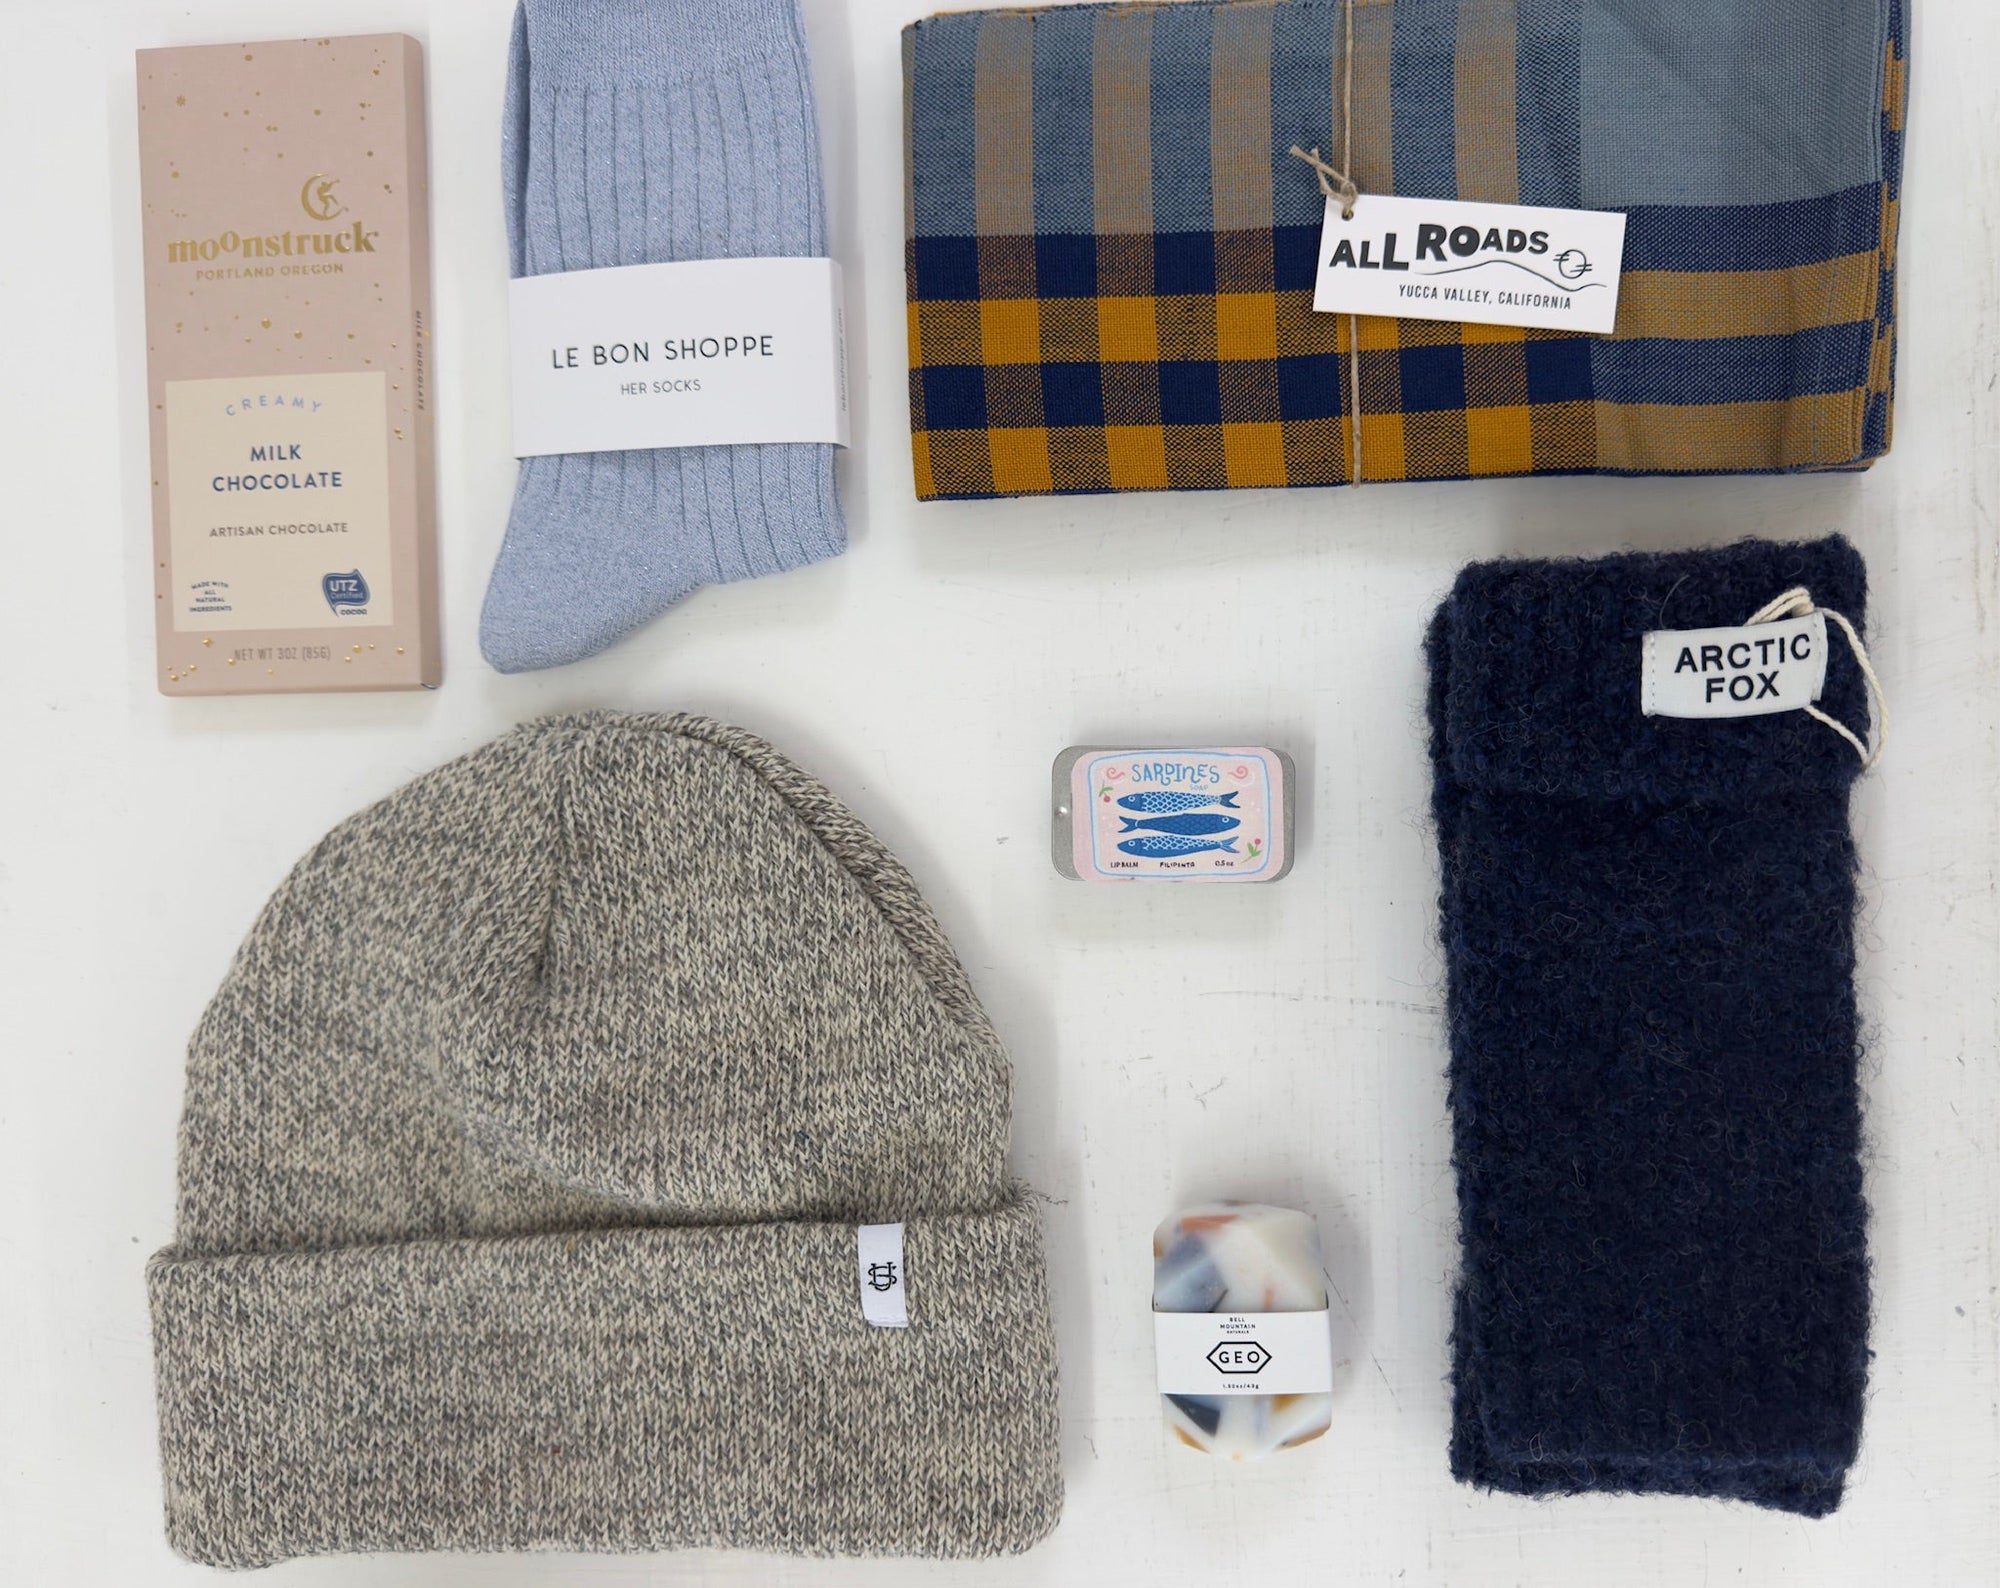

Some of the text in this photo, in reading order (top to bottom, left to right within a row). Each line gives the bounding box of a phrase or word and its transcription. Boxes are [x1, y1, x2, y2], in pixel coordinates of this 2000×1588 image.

[167, 221, 380, 263] moonstruck
[1329, 223, 1549, 271] ALL ROADS
[196, 263, 344, 281] PORTLAND OREGON
[1399, 284, 1572, 310] YUCCA VALLEY, CALIFORNIA
[552, 335, 774, 369] LE BON SHOPPE
[620, 379, 701, 396] HER SOCKS
[225, 395, 322, 416] CREAMY
[250, 444, 302, 462] MILK
[212, 471, 343, 492] CHOCOLATE
[209, 522, 349, 538] ARTISAN CHOCOLATE
[330, 579, 359, 592] UTZ
[234, 647, 254, 661] NET
[256, 647, 273, 660] WT
[1674, 633, 1811, 674] ARCTIC
[1706, 671, 1780, 703] FOX
[1218, 1350, 1260, 1364] GEO
